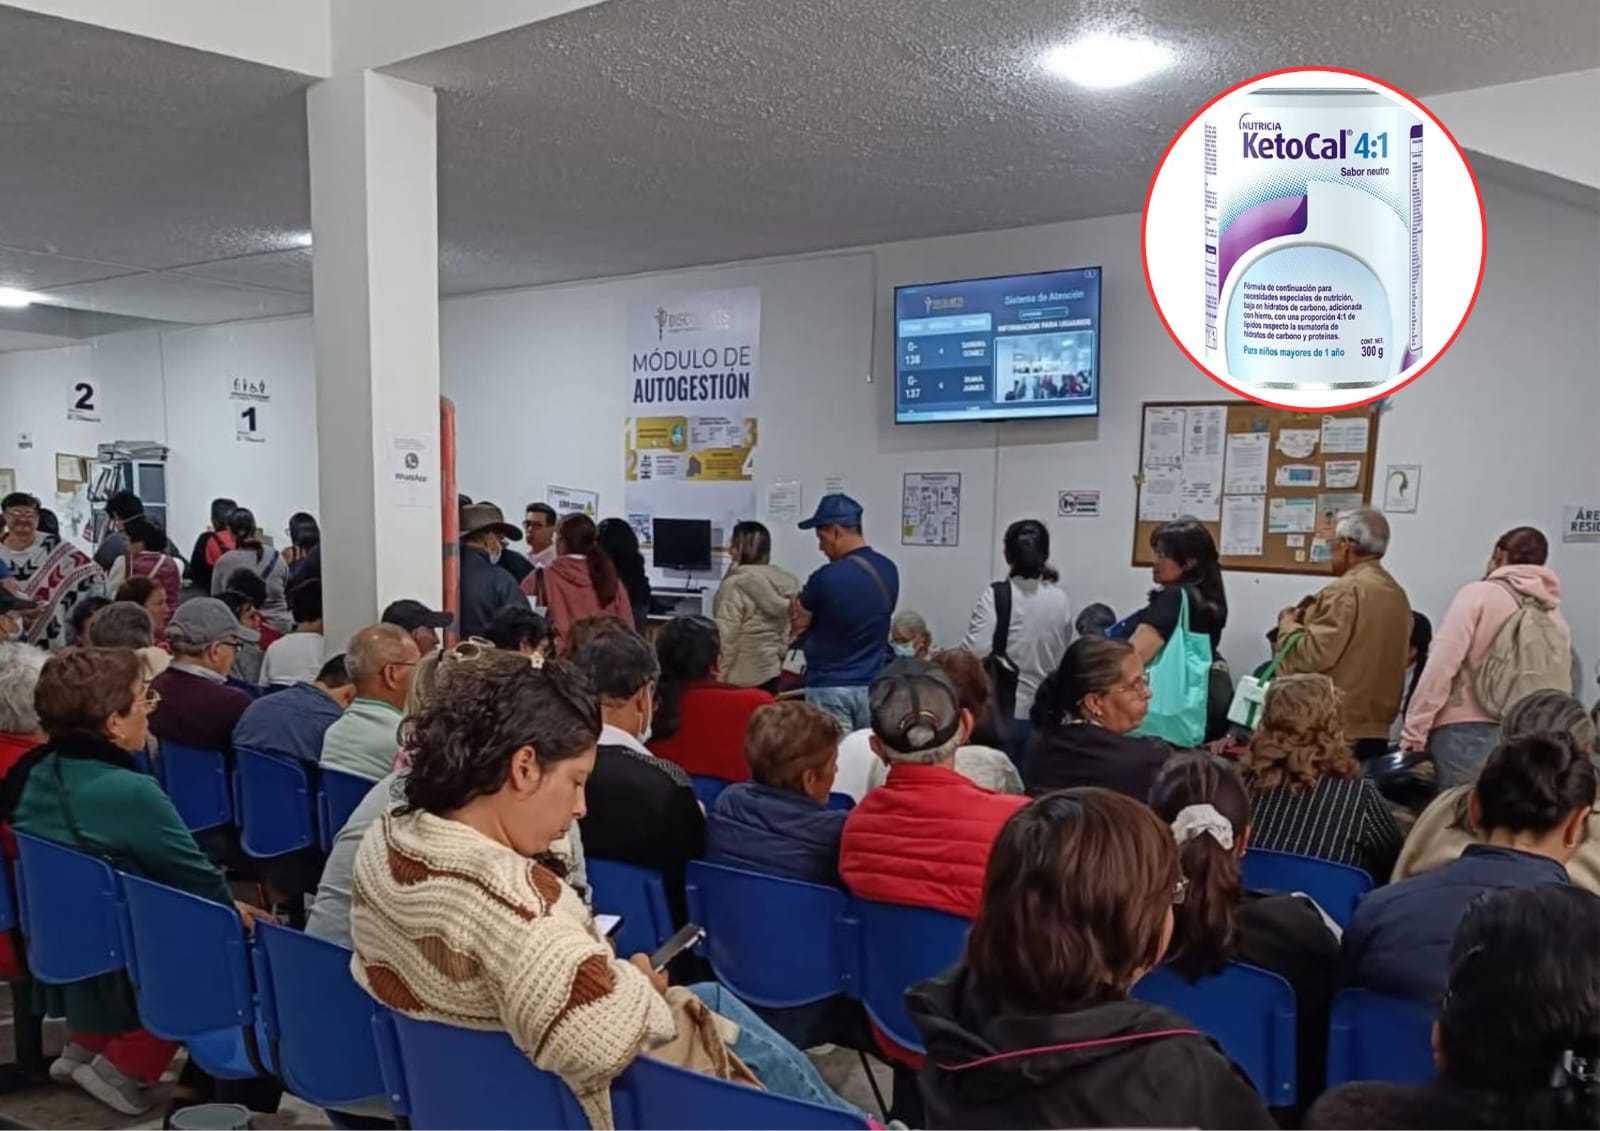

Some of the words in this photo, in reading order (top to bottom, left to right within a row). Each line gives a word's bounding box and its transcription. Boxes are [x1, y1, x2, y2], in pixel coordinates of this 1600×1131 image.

[1242, 122, 1281, 131] NUTRICIA
[1354, 131, 1388, 159] 4:1
[1340, 167, 1364, 177] Sabor
[1367, 167, 1389, 176] neutro
[1243, 282, 1265, 291] Fórmula
[1276, 284, 1316, 292] continuación
[1243, 293, 1278, 301] necesidades
[1280, 294, 1312, 303] especiales
[1243, 302, 1254, 311] baja
[1264, 303, 1288, 311] hidratos
[1299, 304, 1328, 312] carbono,
[1329, 303, 1362, 311] adicionada
[1300, 313, 1335, 322] proporción
[1263, 323, 1289, 331] respecto
[1297, 323, 1329, 331] sumatoria
[1243, 331, 1265, 339] hidratos
[1276, 332, 1301, 340] carbono
[1243, 345, 1257, 354] Para
[1259, 346, 1278, 356] niños
[1280, 349, 1311, 359] mayores
[1313, 348, 1322, 356] de
[1331, 347, 1345, 356] año
[1361, 345, 1376, 357] 300
[1378, 347, 1384, 358] g
[633, 347, 717, 373] MÓDULO
[724, 346, 750, 367] DE
[633, 367, 750, 404] AUTOGESTIÓN
[75, 382, 94, 411] 2
[242, 406, 256, 432] 1
